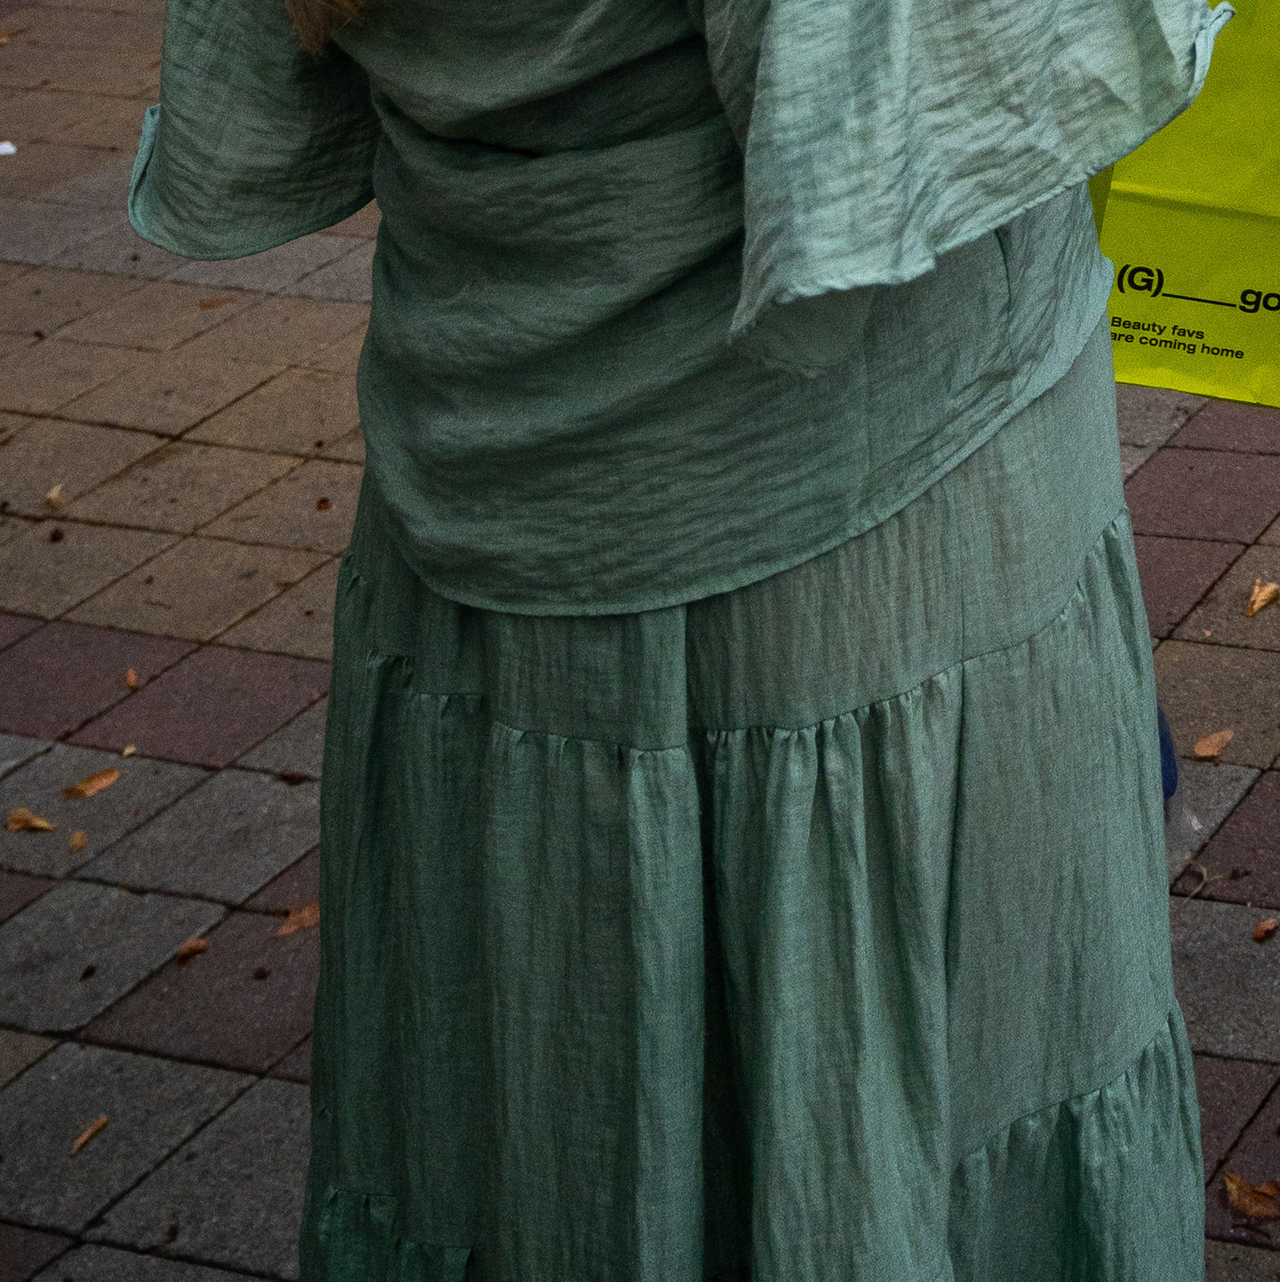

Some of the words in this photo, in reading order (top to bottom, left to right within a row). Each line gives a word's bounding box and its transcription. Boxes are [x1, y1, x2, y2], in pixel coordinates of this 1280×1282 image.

[1111, 316, 1167, 335] Beauty
[1171, 324, 1205, 340] favs
[1110, 331, 1135, 343] are
[1138, 336, 1197, 354] coming
[1201, 343, 1245, 359] home
